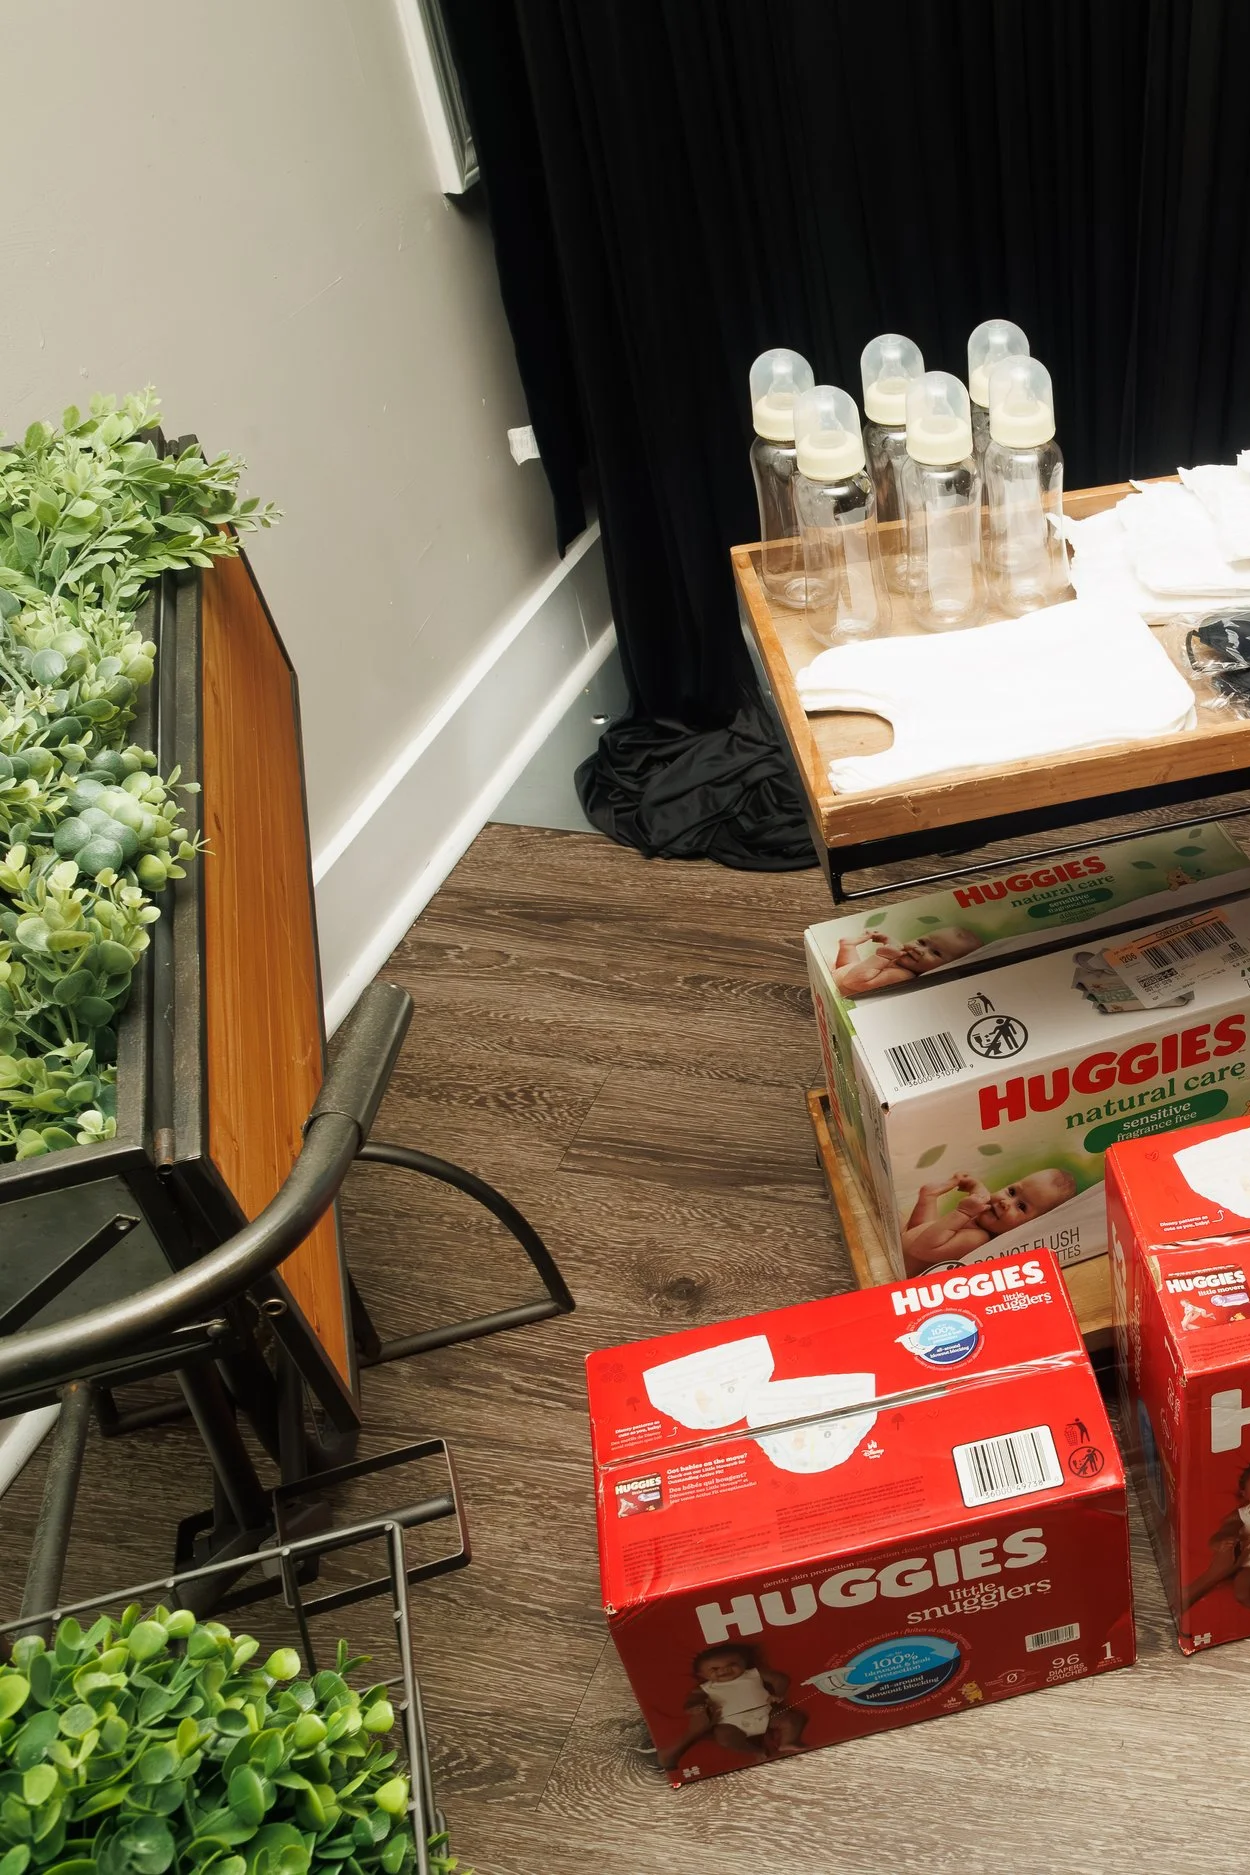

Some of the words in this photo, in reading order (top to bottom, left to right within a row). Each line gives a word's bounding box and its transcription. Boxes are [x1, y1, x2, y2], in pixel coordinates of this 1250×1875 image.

[953, 856, 1106, 908] HUGGIES
[1011, 884, 1075, 907] natural
[1078, 874, 1115, 890] care
[1155, 920, 1194, 938] CONVEYABLE
[908, 1074, 933, 1088] 36000
[936, 1067, 960, 1079] 51079
[979, 1014, 1247, 1130] HUGGIES
[1065, 1078, 1176, 1130] natural
[1183, 1061, 1247, 1091] care
[1116, 1118, 1172, 1142] fragrance
[1174, 1109, 1197, 1126] free
[1122, 1101, 1192, 1131] sensitive
[1033, 1226, 1080, 1250] FLUSH
[891, 1260, 1044, 1316] HUGGIES
[1165, 1270, 1247, 1293] HUGGIES
[1197, 1289, 1216, 1297] little
[1217, 1284, 1245, 1295] movers
[985, 1292, 1052, 1315] snugglers
[1002, 1291, 1024, 1303] little
[680, 1463, 703, 1473] babies
[703, 1460, 713, 1468] on
[714, 1457, 725, 1465] the
[726, 1453, 748, 1463] move?
[615, 1477, 662, 1495] HUGGIES
[985, 1488, 1013, 1499] 36000
[1015, 1480, 1044, 1491] 49738
[696, 1527, 1047, 1644] HUGGIES
[763, 1577, 789, 1590] gentle
[791, 1572, 809, 1582] skin
[810, 1561, 855, 1578] protection
[906, 1576, 1051, 1626] snugglers
[948, 1580, 996, 1601] little
[873, 1652, 918, 1670] 100%
[1052, 1653, 1080, 1670] 96
[1101, 1641, 1115, 1660] 1
[1046, 1667, 1088, 1683] COUCHES
[1049, 1662, 1085, 1677] DIAPERS
[866, 1686, 902, 1700] blowout
[903, 1676, 940, 1690] blocking
[879, 1675, 924, 1691] all-around
